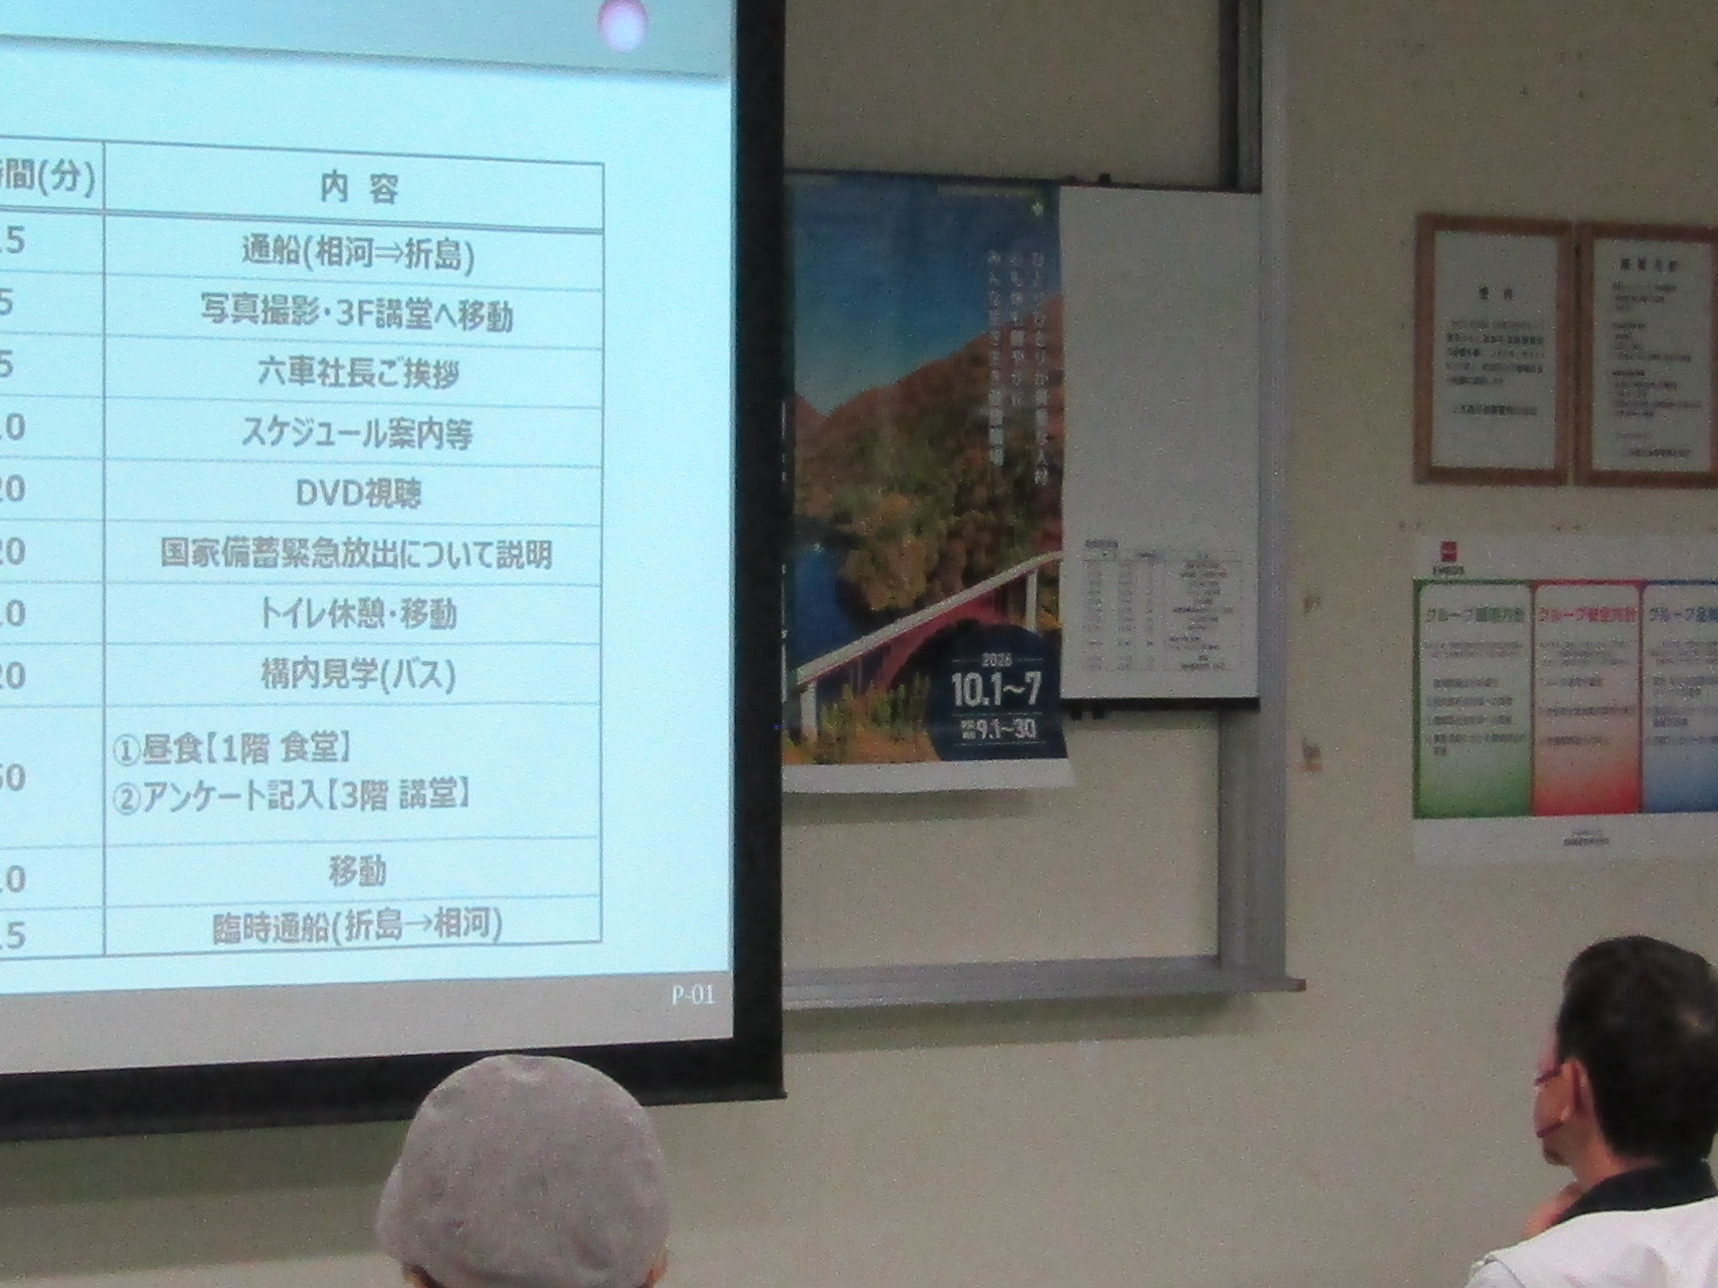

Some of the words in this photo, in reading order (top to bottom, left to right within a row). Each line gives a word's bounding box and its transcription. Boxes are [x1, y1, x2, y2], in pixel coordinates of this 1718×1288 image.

[257, 354, 461, 392] 六車社長ご挨拶
[239, 414, 473, 452] スケジュール案内等
[295, 476, 423, 510] DVD視聴
[159, 536, 553, 570] 国家備蓄緊急放出について説明
[259, 656, 457, 694] 構内見学(バス)
[327, 854, 387, 888] 移動
[669, 982, 717, 1008] P-01
